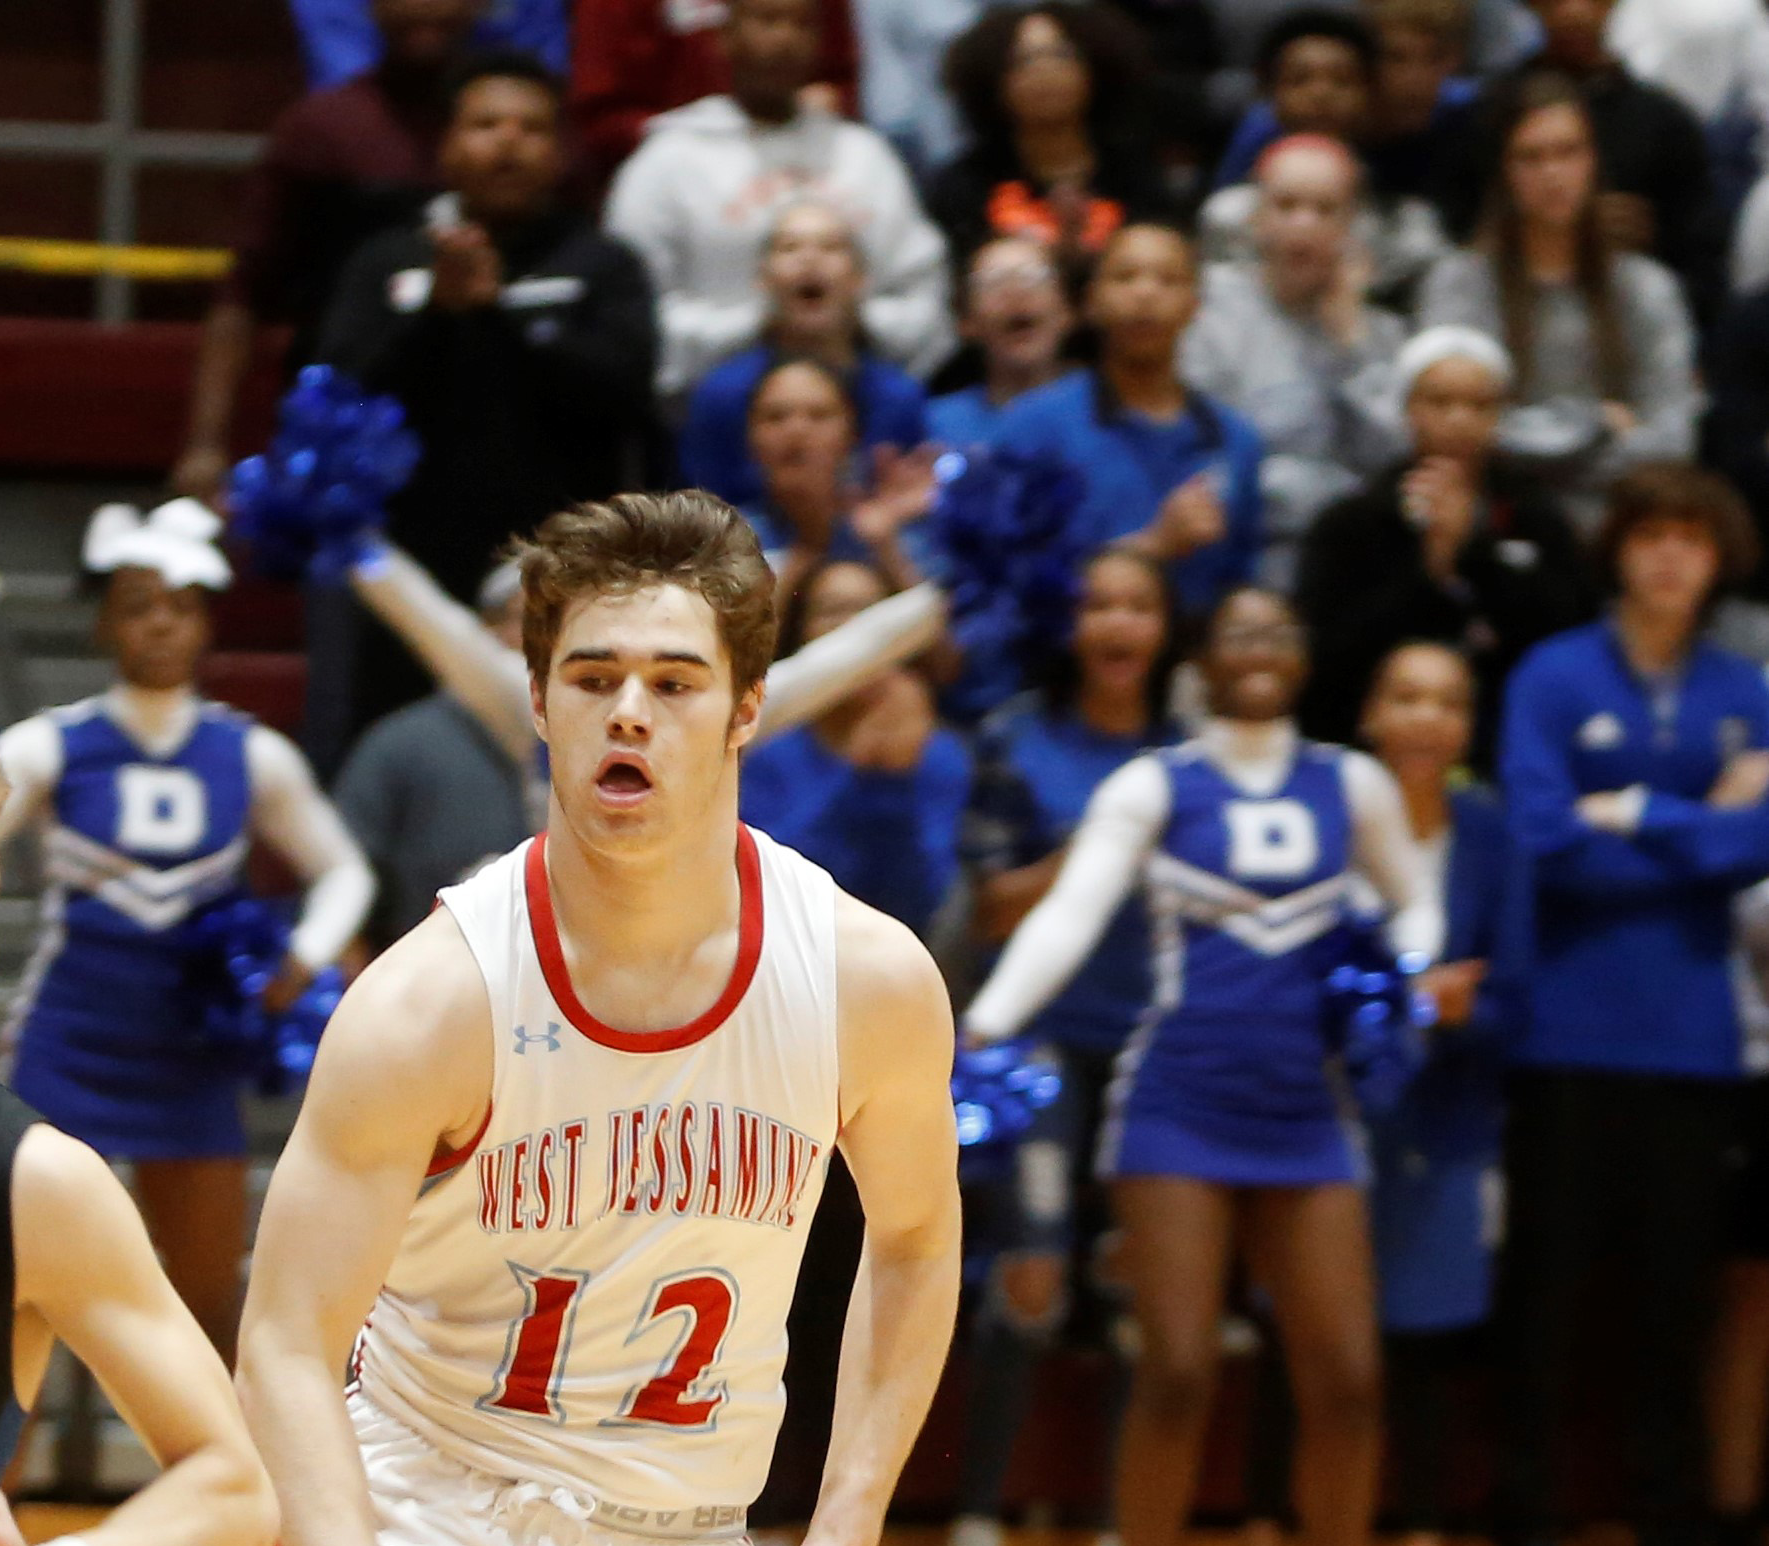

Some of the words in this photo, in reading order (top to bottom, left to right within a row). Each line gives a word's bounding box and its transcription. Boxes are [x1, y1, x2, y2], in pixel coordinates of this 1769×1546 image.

[115, 763, 207, 850] D
[1225, 799, 1318, 875] D
[476, 1117, 587, 1235] WEST
[474, 1260, 741, 1434] 12
